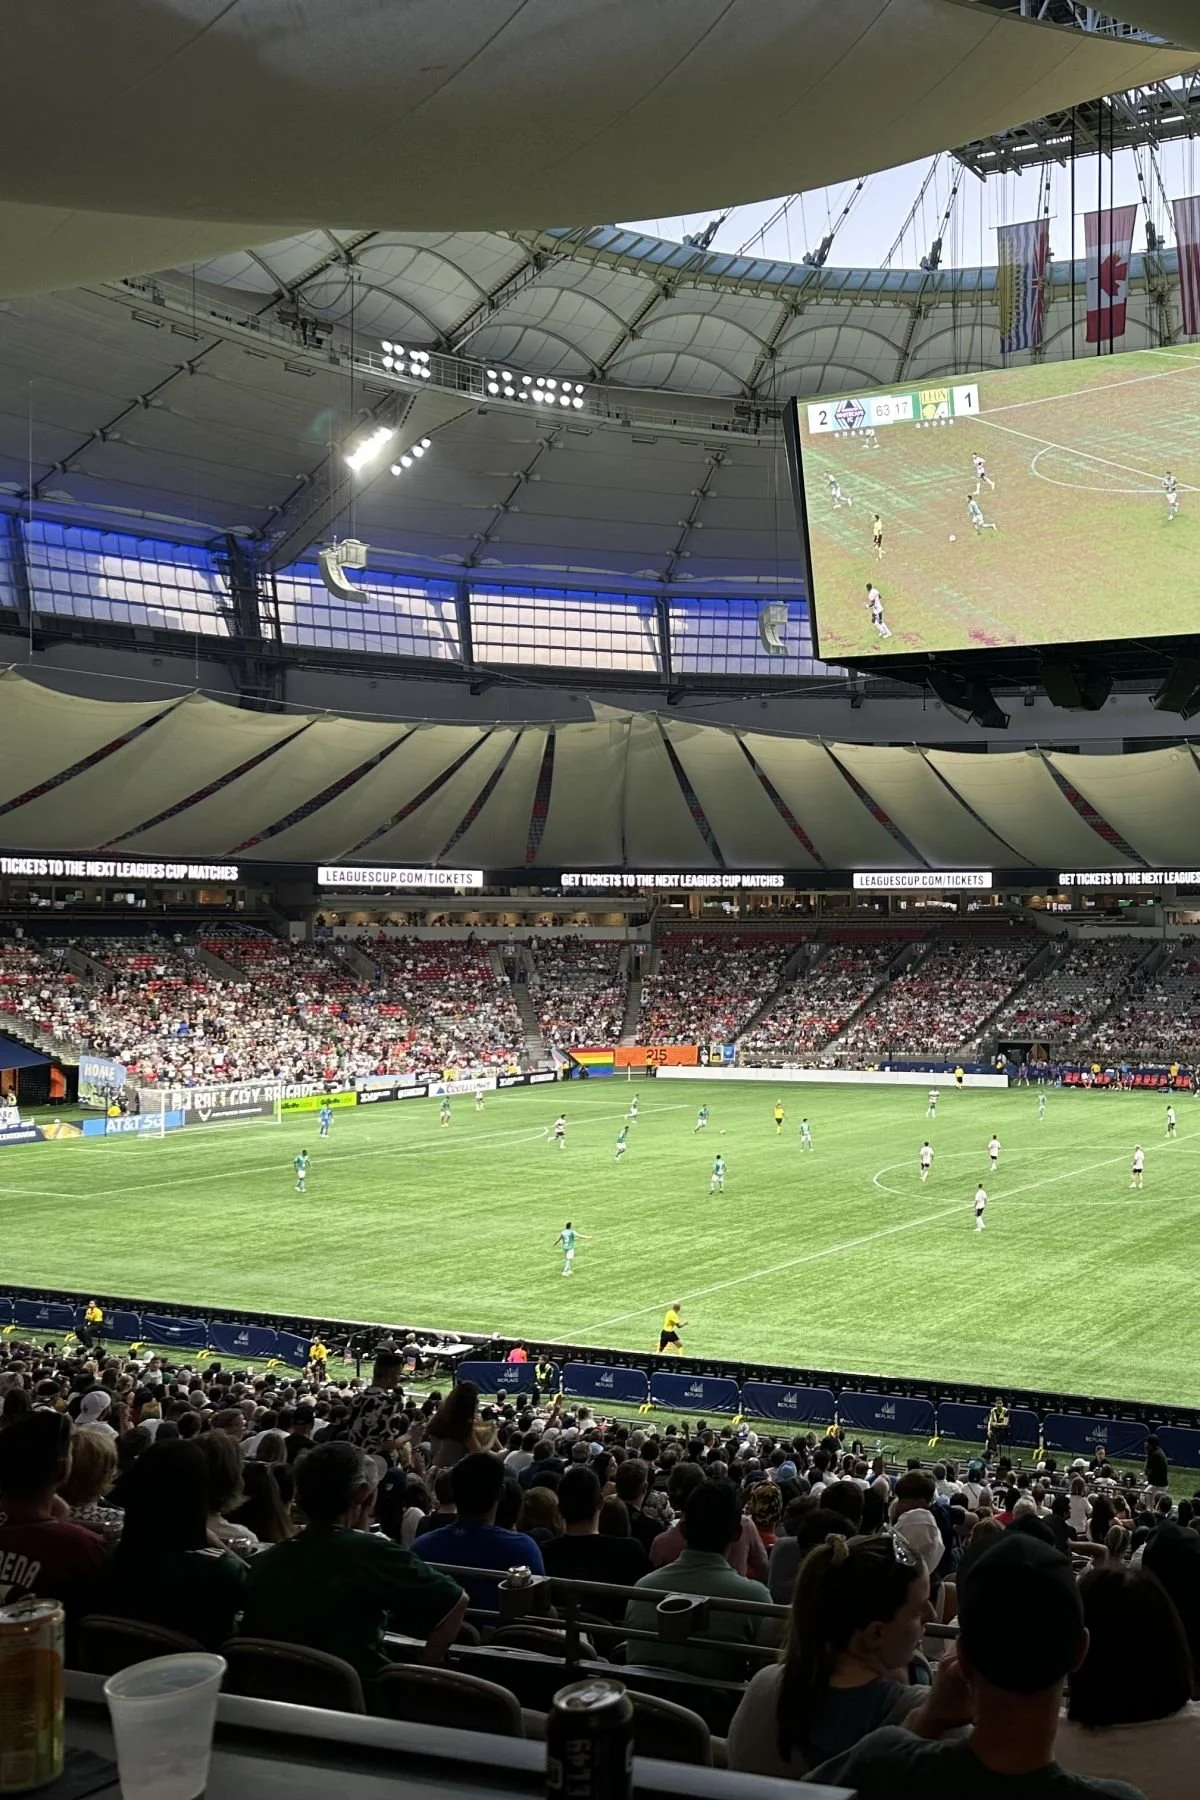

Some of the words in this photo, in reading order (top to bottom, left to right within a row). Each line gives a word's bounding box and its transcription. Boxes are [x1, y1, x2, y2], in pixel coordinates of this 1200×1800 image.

[964, 392, 972, 408] 1
[876, 405, 891, 417] 63
[895, 402, 908, 414] 17
[818, 410, 828, 425] 2
[0, 857, 48, 875] TICKETS
[48, 859, 63, 876] TO
[64, 860, 86, 877] THE
[87, 861, 116, 878] NEXT
[117, 863, 164, 879] LEAGUES
[165, 864, 187, 880] CUP
[188, 865, 238, 881] MATCHES
[325, 870, 473, 884] LEAGUESCUP.COM/TICKETS
[560, 873, 581, 886] GET
[581, 873, 622, 887] TICKETS
[622, 874, 635, 887] TO
[635, 874, 655, 887] THE
[655, 874, 679, 887] NEXT
[680, 874, 721, 887] LEAGUES
[722, 874, 741, 887] CUP
[741, 874, 785, 887] MATCHES
[860, 875, 984, 886] LEAGUESCUP.COM/TICKETS
[1058, 873, 1076, 885] GET
[1076, 872, 1111, 885] TICKETS
[1111, 872, 1123, 885] TO
[1123, 872, 1141, 885] THE
[1141, 872, 1164, 885] NEXT
[646, 1049, 667, 1060] 215
[84, 1062, 116, 1081] HOME
[106, 1116, 141, 1133] AT&T
